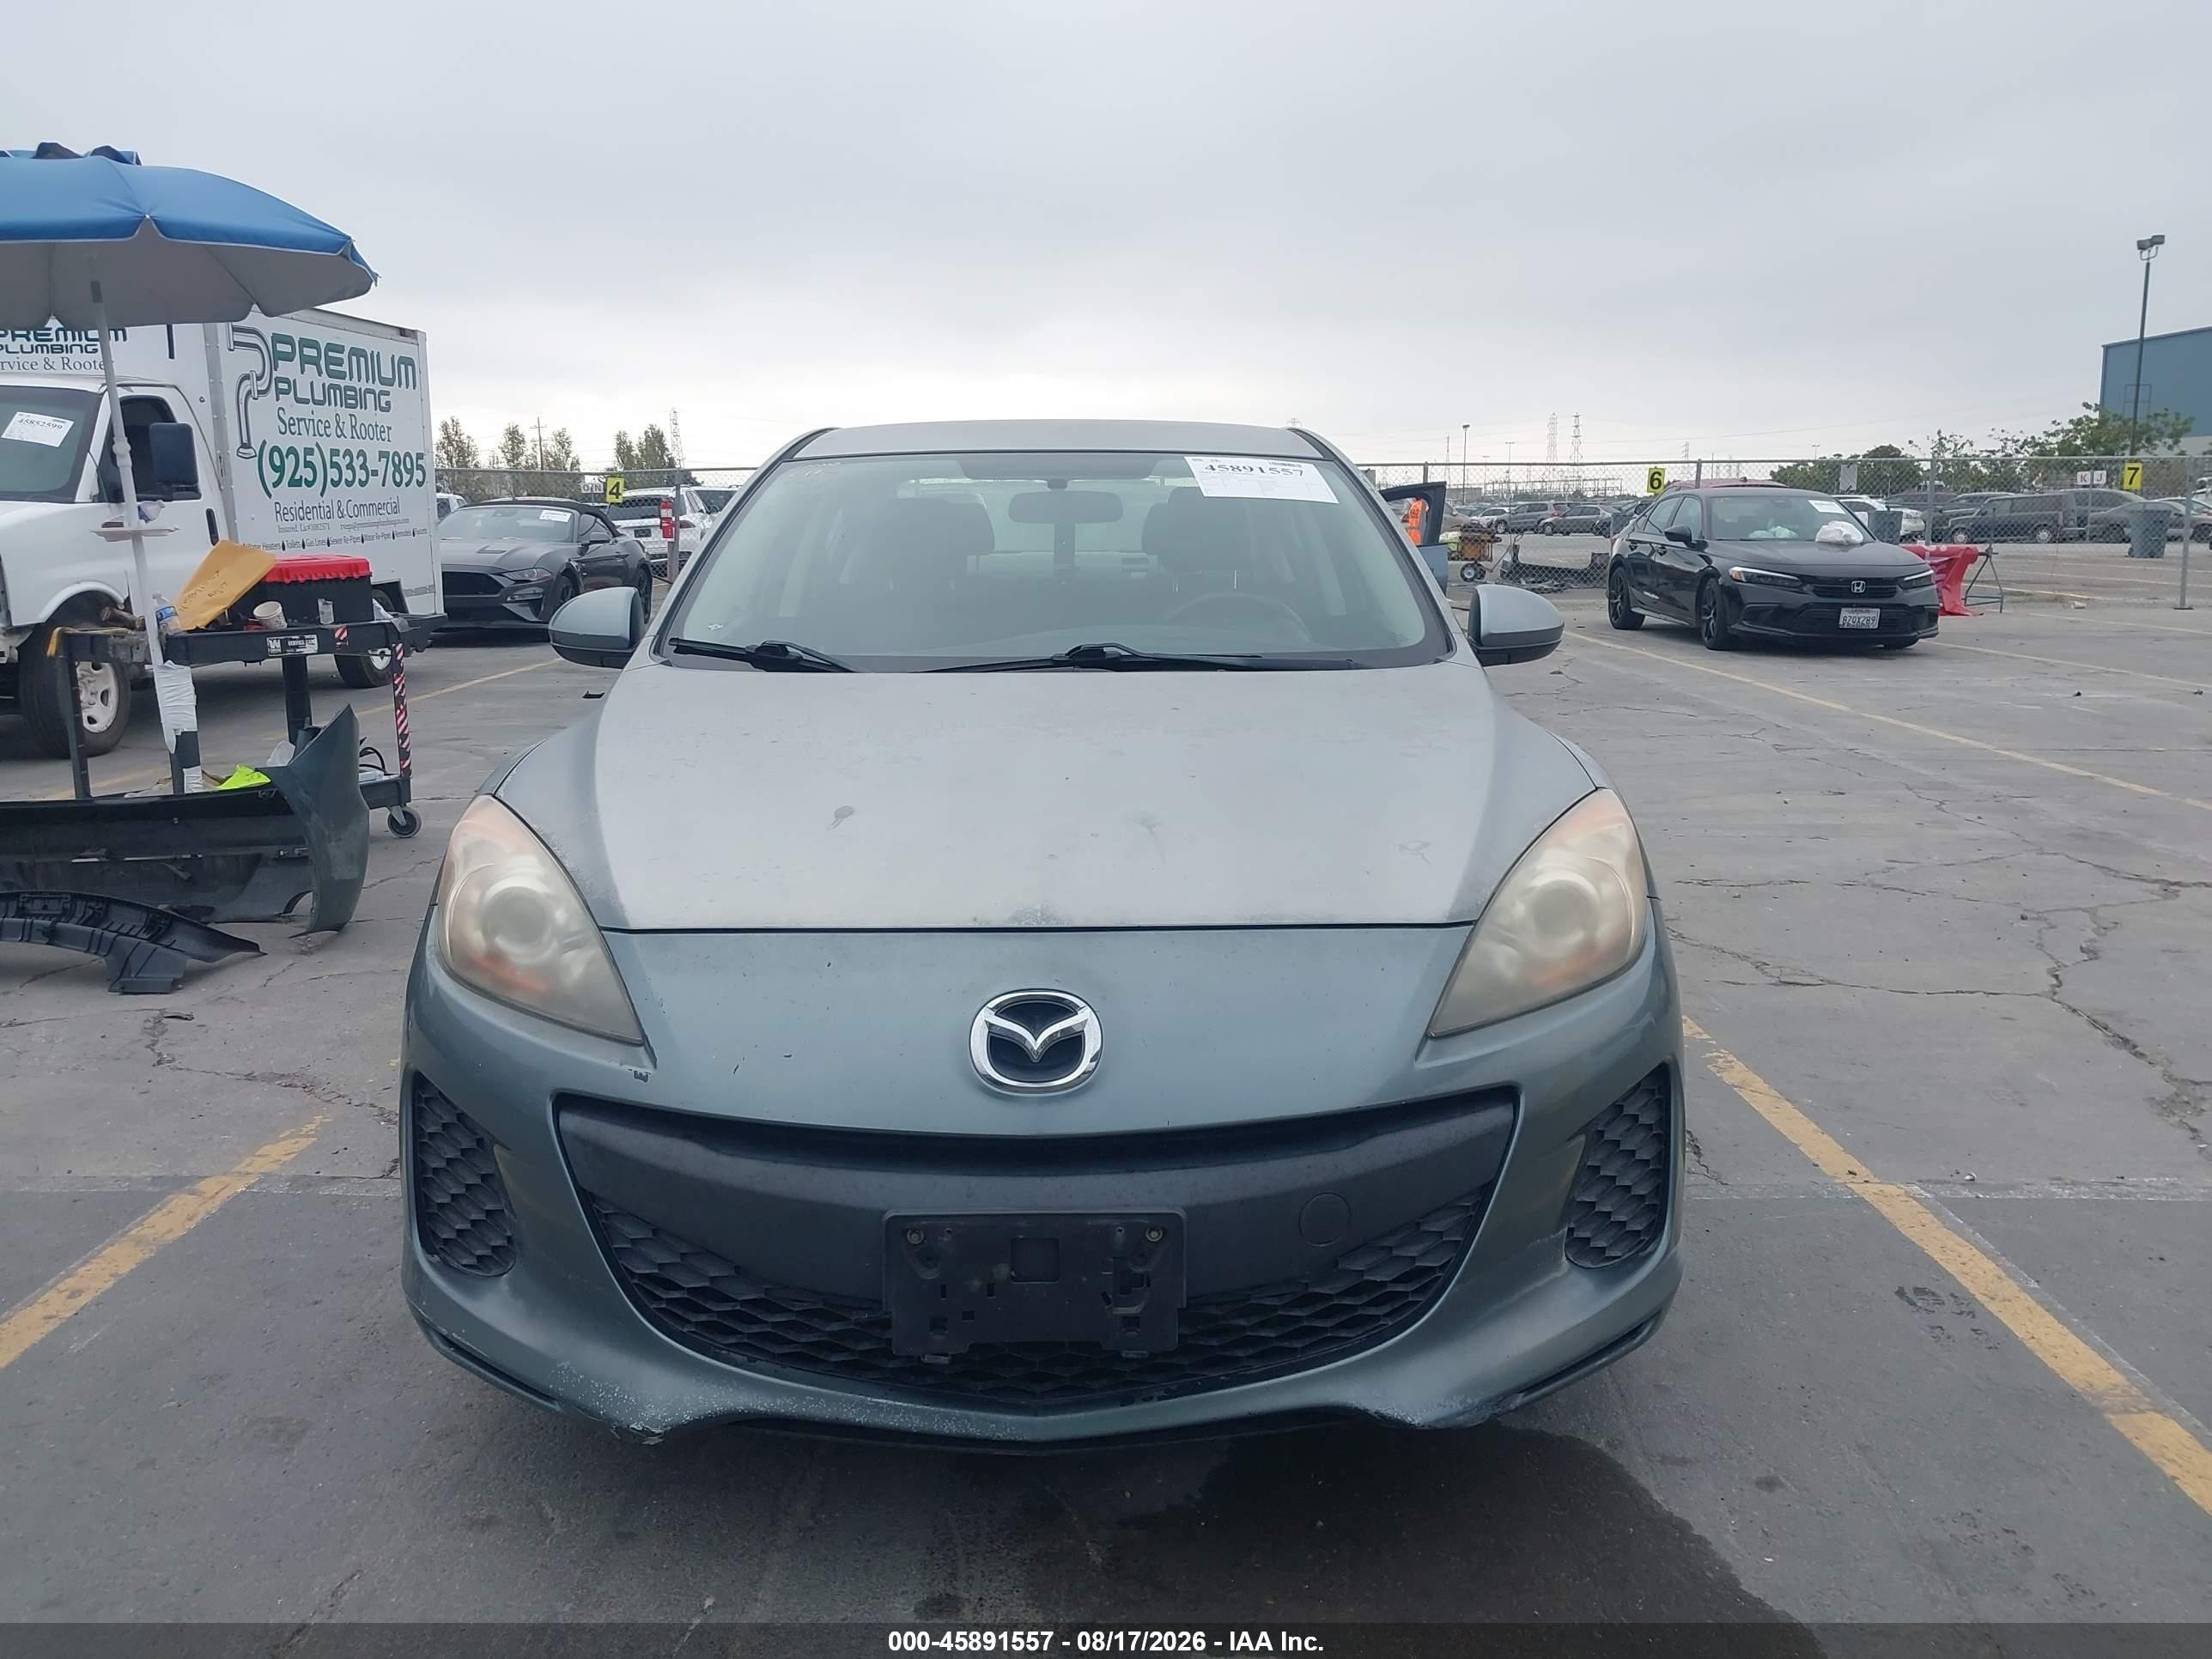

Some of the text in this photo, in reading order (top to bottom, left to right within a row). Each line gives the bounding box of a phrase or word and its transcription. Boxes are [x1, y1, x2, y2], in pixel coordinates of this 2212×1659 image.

[0, 343, 99, 355] LUMBING
[44, 357, 57, 371] &
[61, 357, 113, 371] Roote
[270, 332, 417, 390] PREMIUM
[274, 376, 392, 413] PLUMBING
[277, 407, 392, 443] Service & Rooter
[258, 439, 427, 499] (925)533-7895
[1205, 464, 1304, 477] 45891557
[2080, 474, 2087, 483] K
[2127, 467, 2140, 486] 7
[1650, 471, 1662, 490] 6
[609, 482, 623, 500] 4
[274, 495, 401, 523] Residential & Commercial
